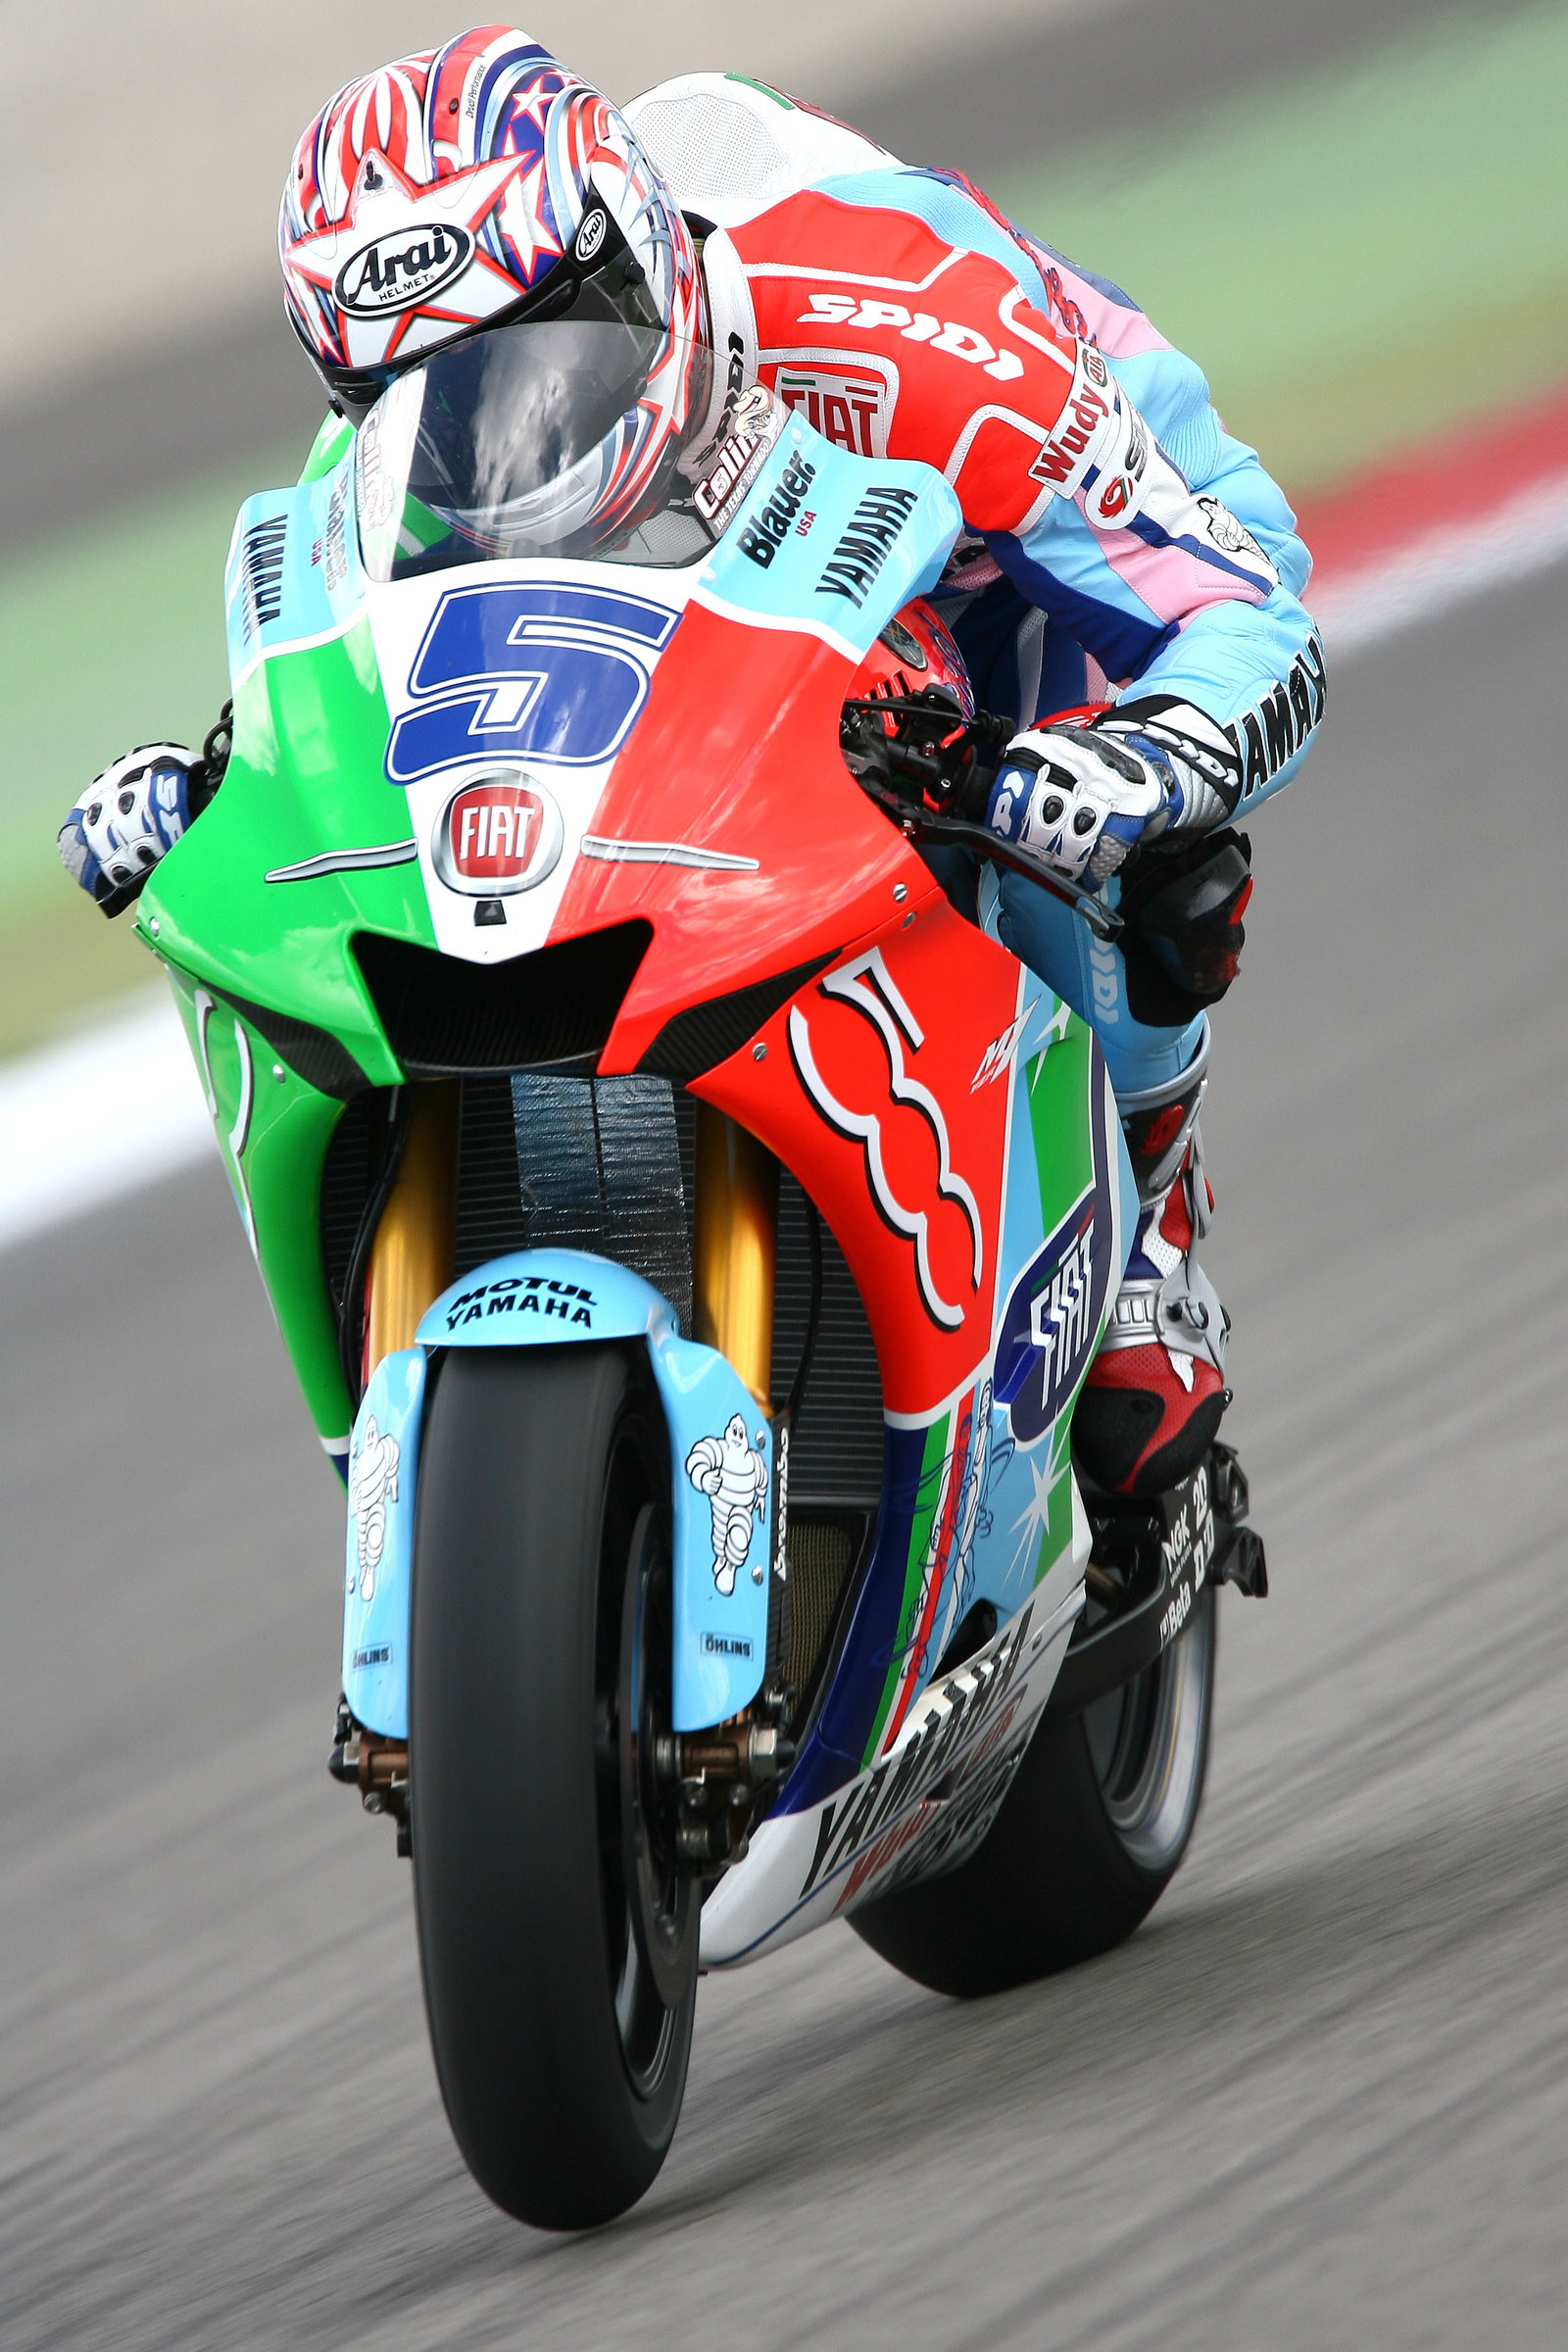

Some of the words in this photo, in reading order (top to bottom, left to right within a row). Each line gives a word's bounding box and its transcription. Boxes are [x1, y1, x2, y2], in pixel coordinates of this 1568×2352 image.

[346, 225, 452, 306] Arai
[378, 273, 429, 302] HELMET
[797, 293, 1025, 381] SPIDI
[1032, 383, 1109, 484] Wudy
[713, 508, 730, 531] THE
[795, 511, 817, 537] USA
[815, 486, 918, 610] YAMAHA
[242, 514, 289, 648] YAMAHA
[383, 580, 684, 786] 5
[459, 805, 535, 860] FIAT
[446, 1294, 592, 1332] YAMAHA
[448, 1277, 598, 1314] MOTUL
[1030, 1218, 1095, 1412] FIAT
[1161, 1503, 1191, 1574] NGK
[706, 1633, 751, 1657] ÖHLINS
[1168, 1580, 1192, 1640] Beta
[799, 1599, 1035, 1899] YAMAHA
